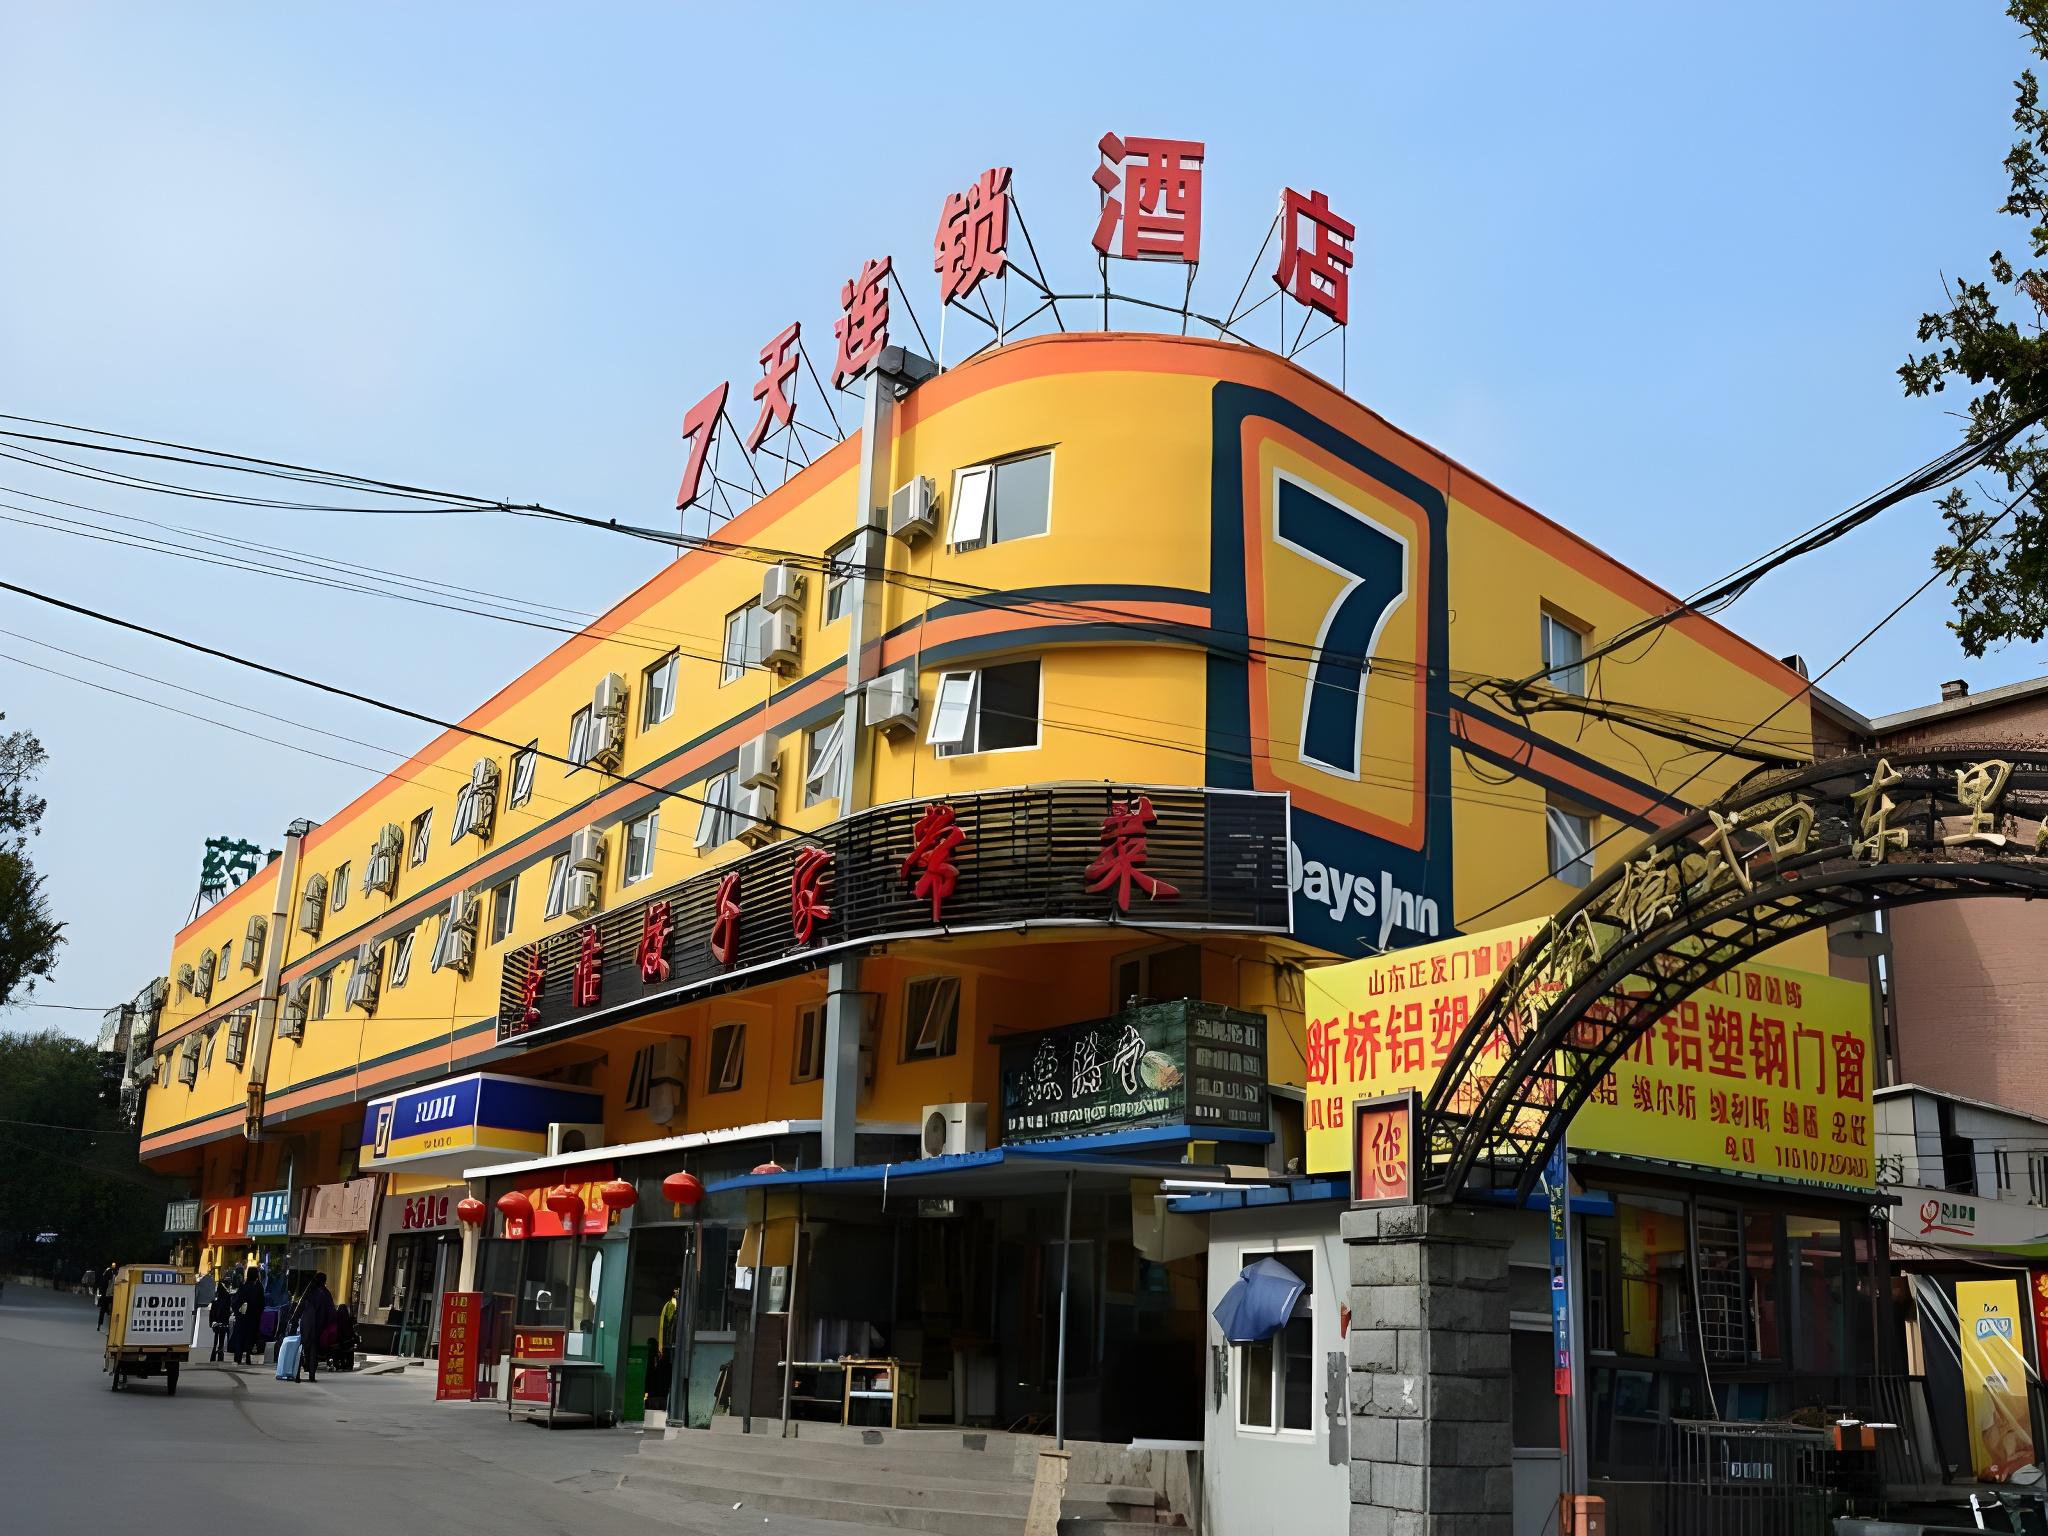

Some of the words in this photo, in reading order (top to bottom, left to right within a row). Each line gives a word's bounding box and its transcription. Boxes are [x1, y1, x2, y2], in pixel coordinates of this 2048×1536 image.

[677, 131, 1355, 510] 7天连锁酒店
[1273, 467, 1408, 781] 7
[1371, 1112, 1408, 1187] 您
